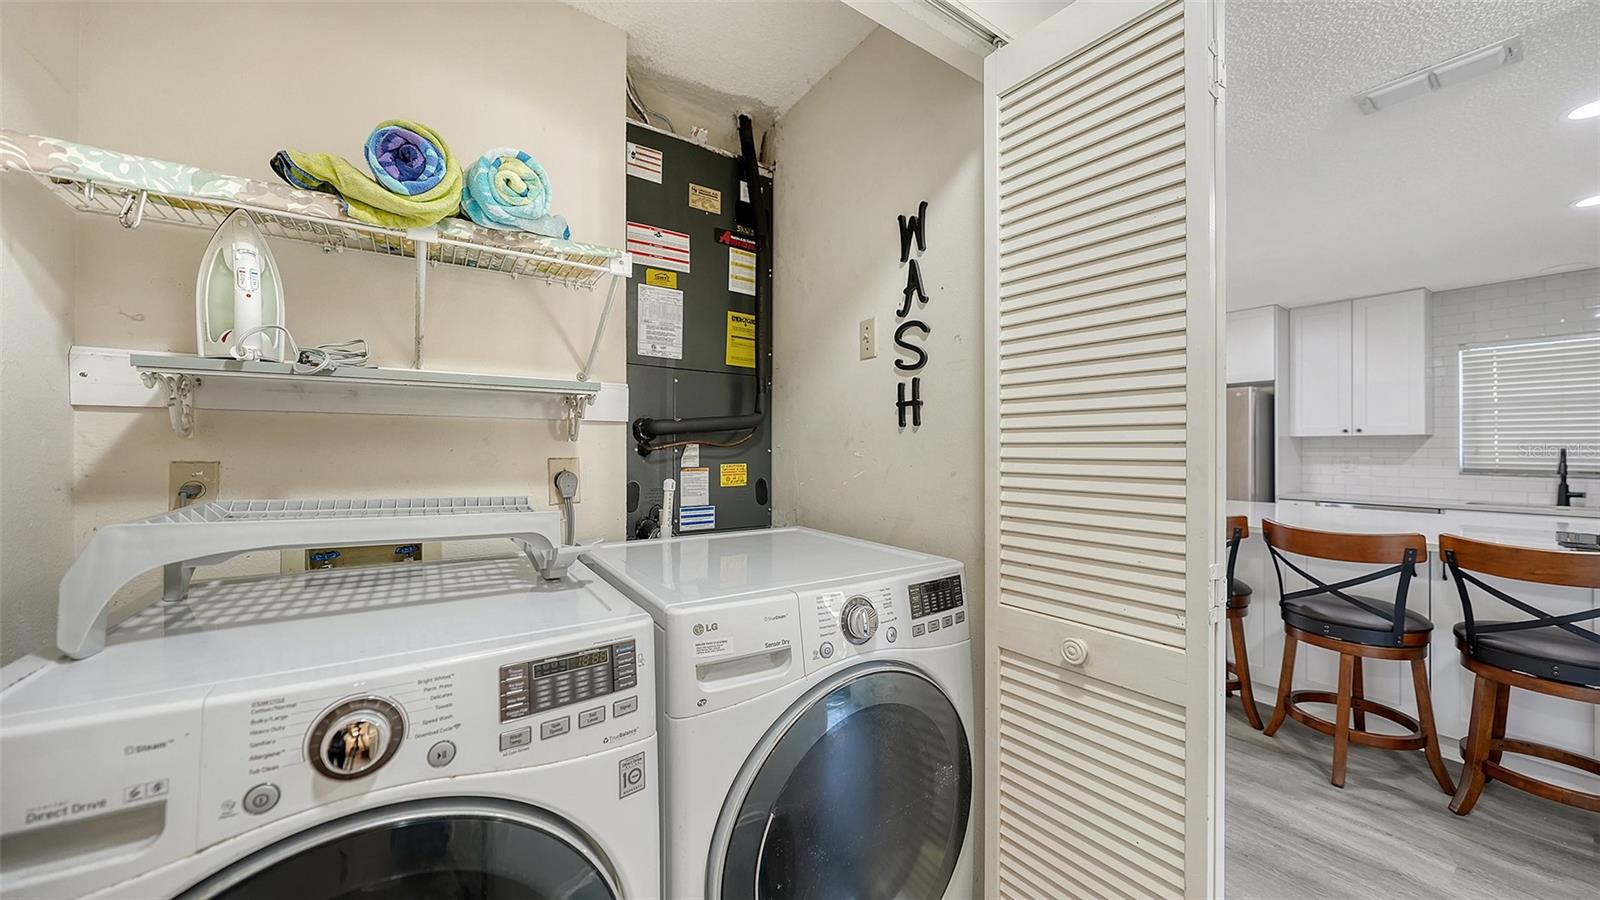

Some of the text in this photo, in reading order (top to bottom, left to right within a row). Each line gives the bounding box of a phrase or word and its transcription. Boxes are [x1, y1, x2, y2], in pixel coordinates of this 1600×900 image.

[895, 201, 931, 428] WASH
[705, 622, 719, 632] LG
[764, 641, 781, 649] Sensor
[25, 807, 69, 825] Direct
[71, 799, 107, 815] Drive
